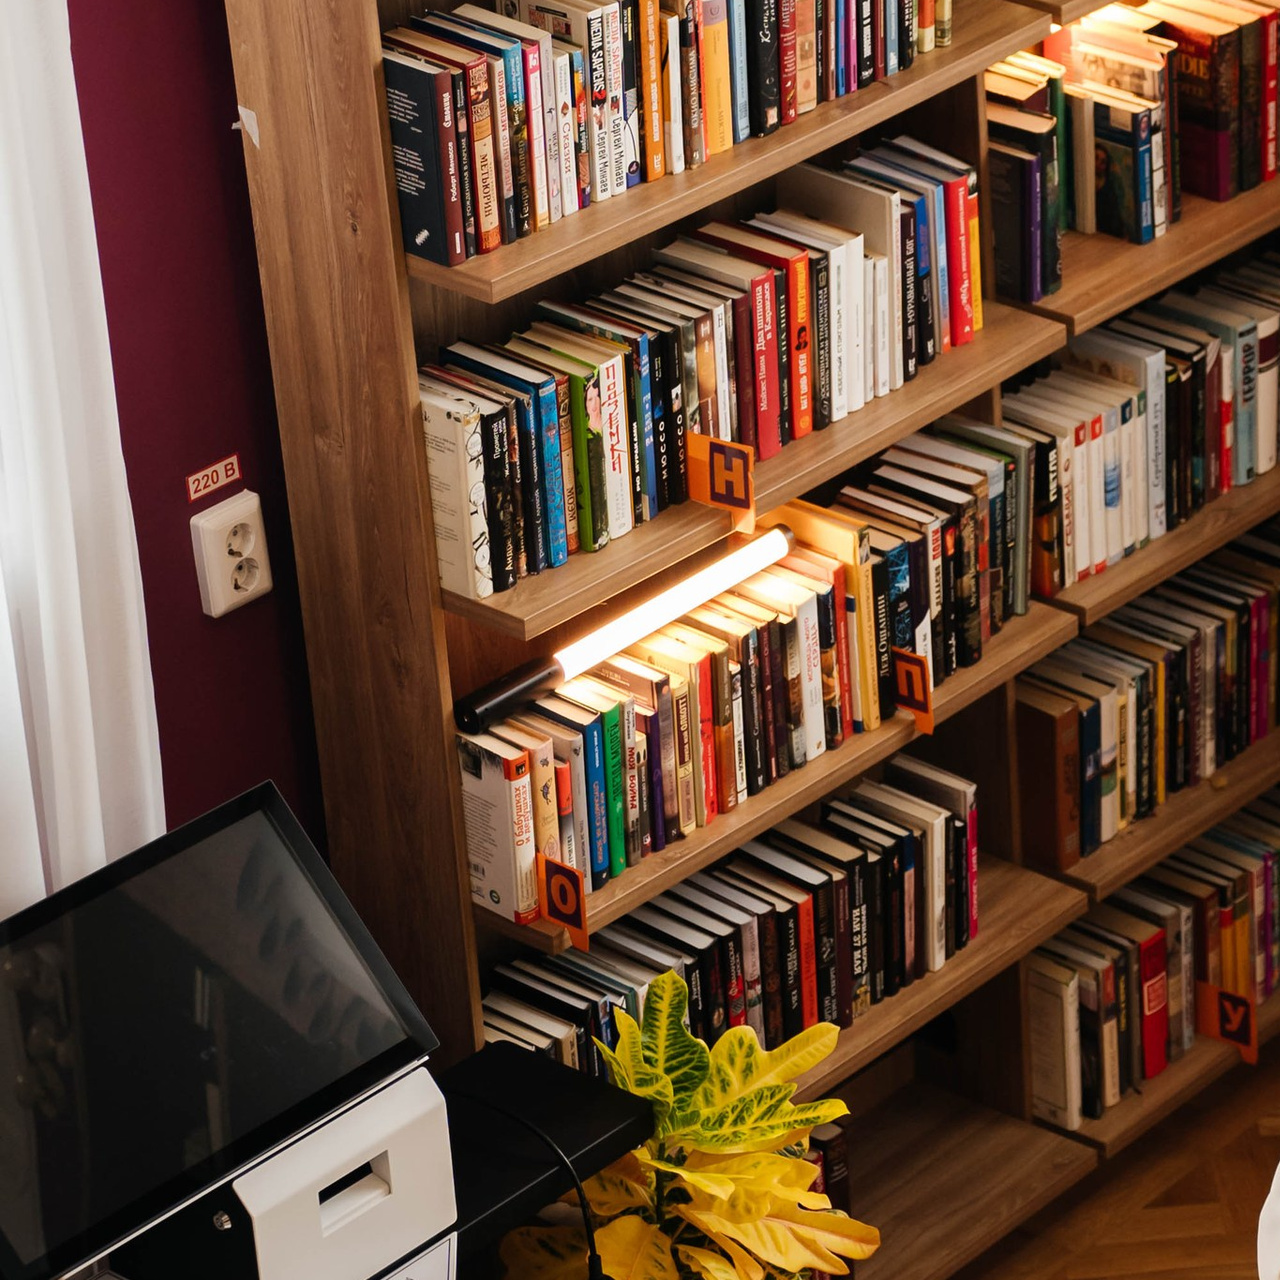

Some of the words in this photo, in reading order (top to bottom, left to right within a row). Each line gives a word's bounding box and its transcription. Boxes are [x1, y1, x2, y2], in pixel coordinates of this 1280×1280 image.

[588, 16, 598, 48] MEDIA
[609, 10, 619, 41] MEDIA
[592, 48, 605, 91] SAPIENS
[611, 44, 621, 91] SAPIENS
[686, 49, 698, 94] МИСИМА
[496, 69, 508, 131] МЕЩЕРЯКОВ
[593, 90, 606, 108] 2
[689, 96, 700, 128] ЮКИО
[561, 122, 572, 173] Сказки
[597, 130, 608, 159] Сергей
[612, 116, 624, 149] Сергей
[447, 141, 455, 173] Менассе
[502, 134, 512, 192] АЛЕКСАНДР
[516, 139, 527, 183] Миллер
[599, 160, 608, 192] Минаев
[614, 150, 624, 187] Минаев
[449, 174, 458, 201] Роберт
[518, 185, 530, 218] Генри
[906, 238, 914, 254] БОГ
[754, 285, 764, 329] шпиона
[762, 281, 772, 330] Каракасе
[905, 256, 914, 323] МУРАВЬИНЫЙ
[755, 330, 765, 350] Два
[630, 421, 642, 472] МУРАКАМИ
[658, 420, 668, 479] МЮССО
[676, 414, 685, 473] МЮССО
[192, 470, 219, 495] 220
[224, 462, 236, 479] В
[714, 446, 745, 503] Н
[1048, 448, 1057, 501] ПЕТЛЯ
[503, 537, 514, 570] Андре
[931, 527, 940, 559] ПОНИ
[877, 594, 887, 651] ОШАНИН
[880, 653, 889, 676] ЛЕВ
[627, 746, 635, 770] МОЯ
[520, 783, 530, 834] дедушках
[628, 774, 636, 809] ВОЙНА
[510, 786, 524, 837] бабушках
[550, 873, 577, 915] О
